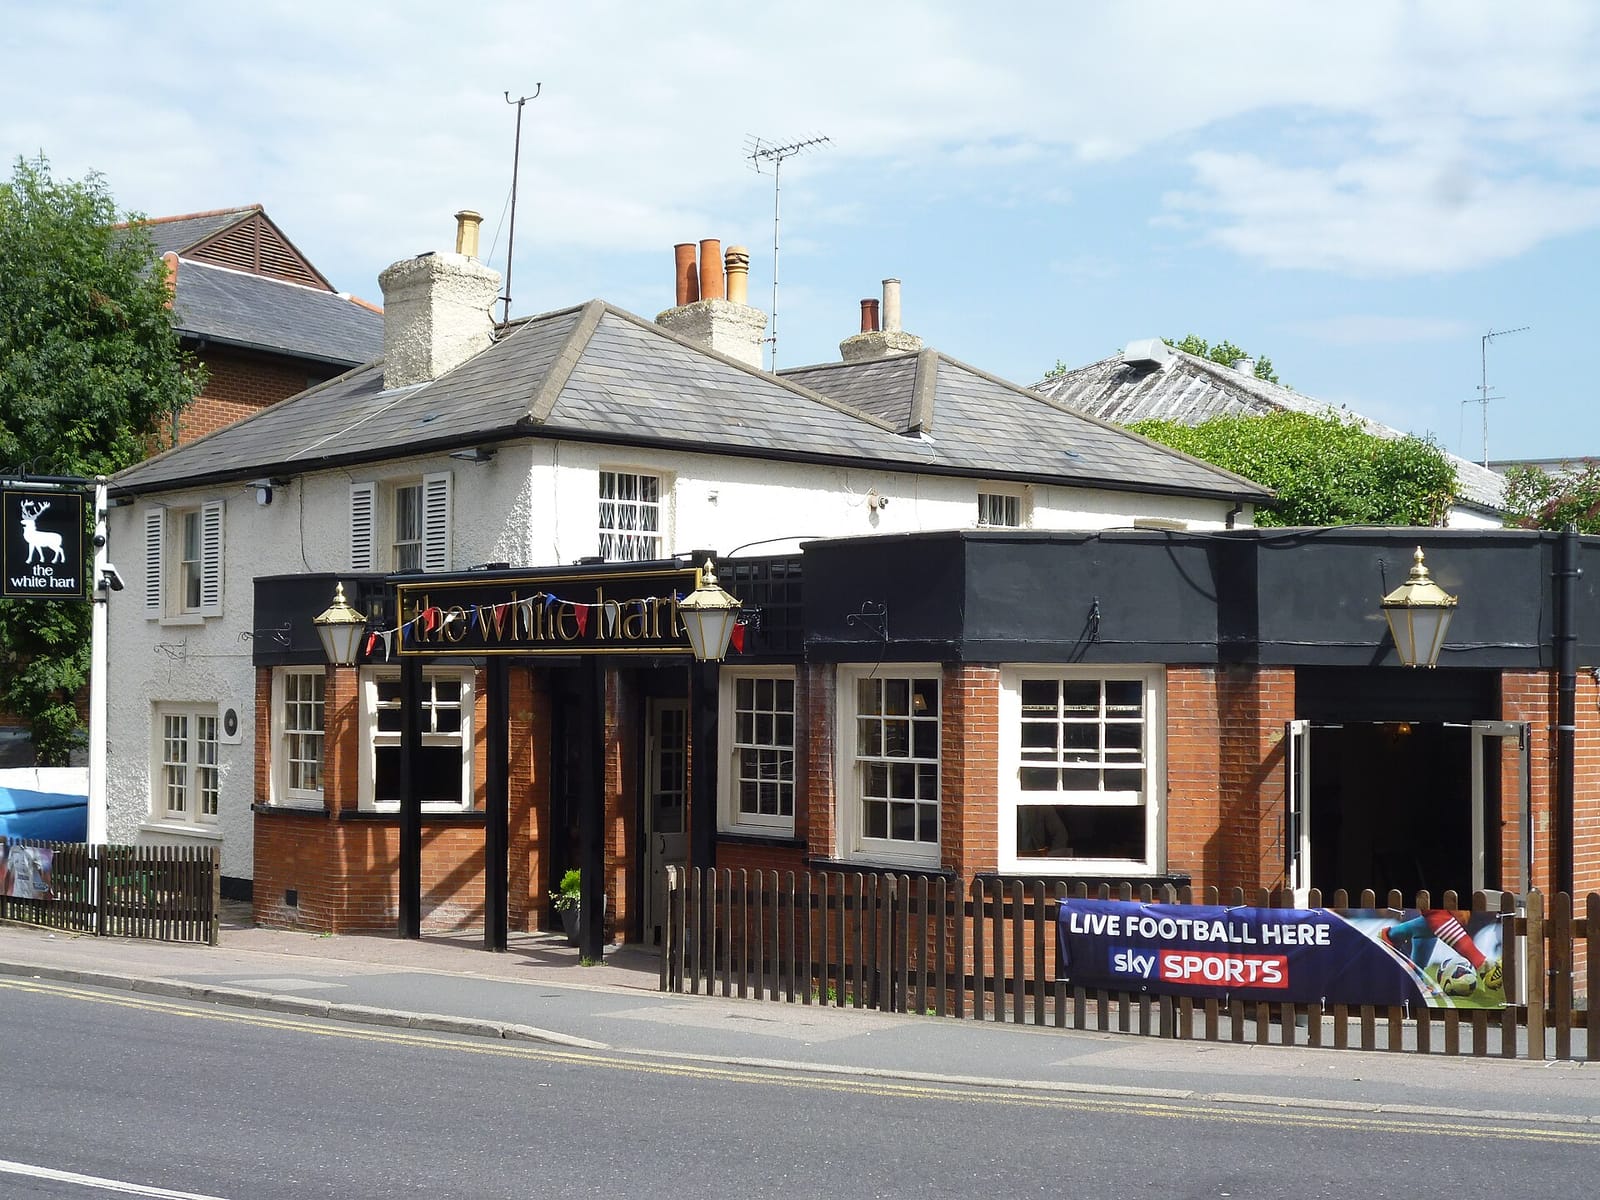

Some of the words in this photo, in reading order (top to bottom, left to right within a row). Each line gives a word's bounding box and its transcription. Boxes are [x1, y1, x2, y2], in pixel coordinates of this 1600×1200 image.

[11, 575, 47, 588] white
[49, 576, 75, 588] hart
[33, 564, 53, 576] the
[413, 593, 468, 642] the
[596, 585, 681, 640] hart
[1070, 912, 1120, 936] LIVE
[1126, 916, 1257, 944] FOOTBALL
[1262, 923, 1331, 945] HERE
[1114, 949, 1156, 979] sky
[1164, 955, 1283, 983] SPORTS
